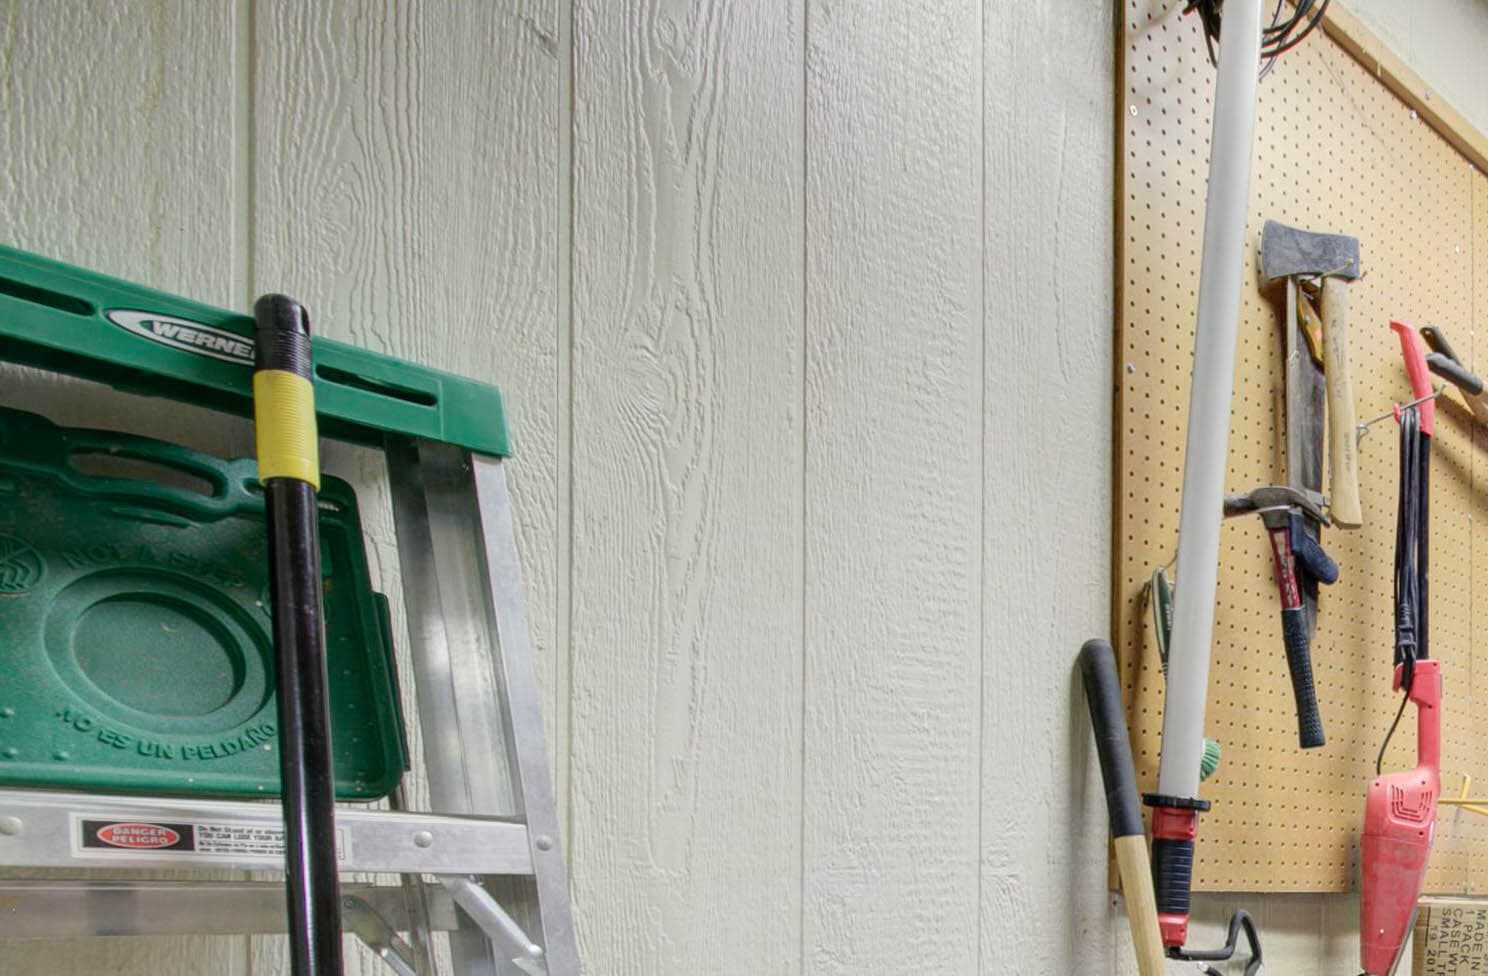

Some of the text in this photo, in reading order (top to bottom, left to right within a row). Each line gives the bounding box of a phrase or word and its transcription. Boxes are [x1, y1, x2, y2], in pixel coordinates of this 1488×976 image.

[152, 320, 255, 359] WERNE
[97, 729, 131, 750] ES
[137, 740, 174, 760] UN
[112, 826, 166, 835] DANGER
[113, 834, 168, 843] PELIGRO
[1437, 908, 1451, 957] SMALL
[1450, 908, 1464, 948] CASE
[1459, 925, 1473, 965] PACK
[1472, 910, 1487, 952] MADE
[1469, 956, 1481, 970] IN
